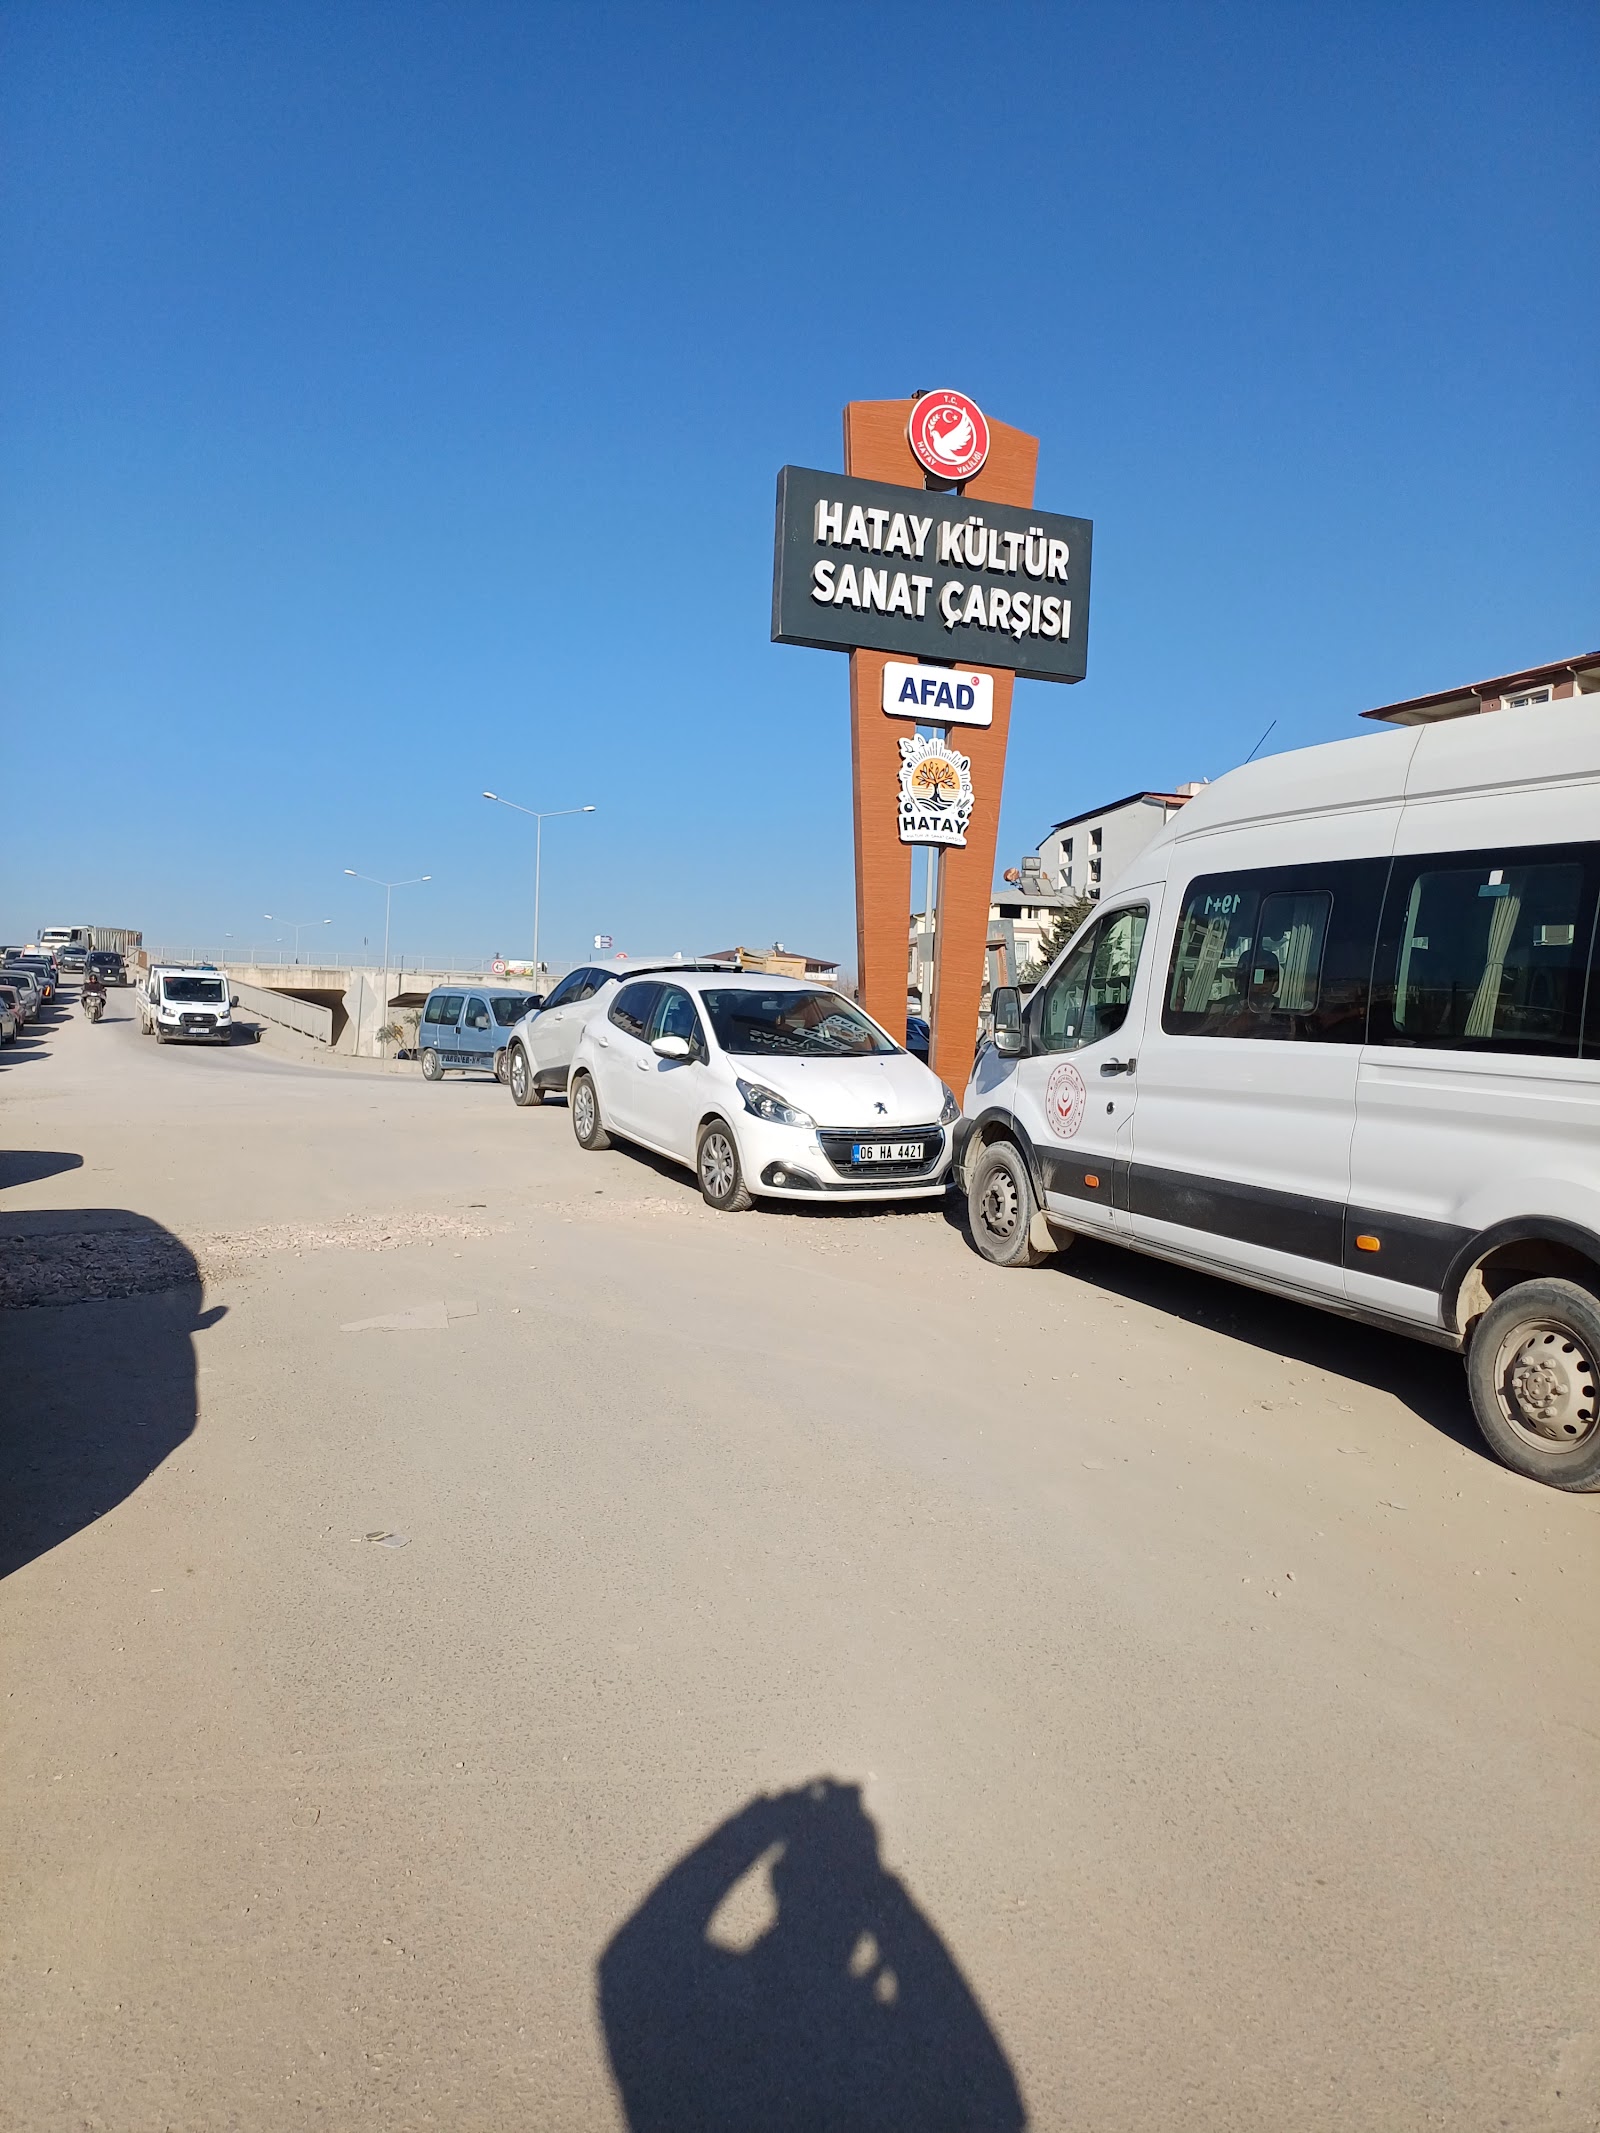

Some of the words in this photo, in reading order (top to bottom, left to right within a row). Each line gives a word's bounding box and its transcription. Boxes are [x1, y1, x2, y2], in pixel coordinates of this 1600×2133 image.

[943, 395, 958, 405] T.C.
[917, 441, 937, 466] HATAY
[816, 499, 934, 557] HATAY
[939, 515, 1070, 580] KÜLTÜR
[810, 560, 933, 617] SANAT
[939, 580, 1072, 640] ÇARŞISI
[898, 677, 975, 711] AFAD
[903, 816, 967, 834] HATAY
[860, 1146, 873, 1159] 06
[880, 1145, 892, 1159] HA
[897, 1144, 921, 1158] 4421
